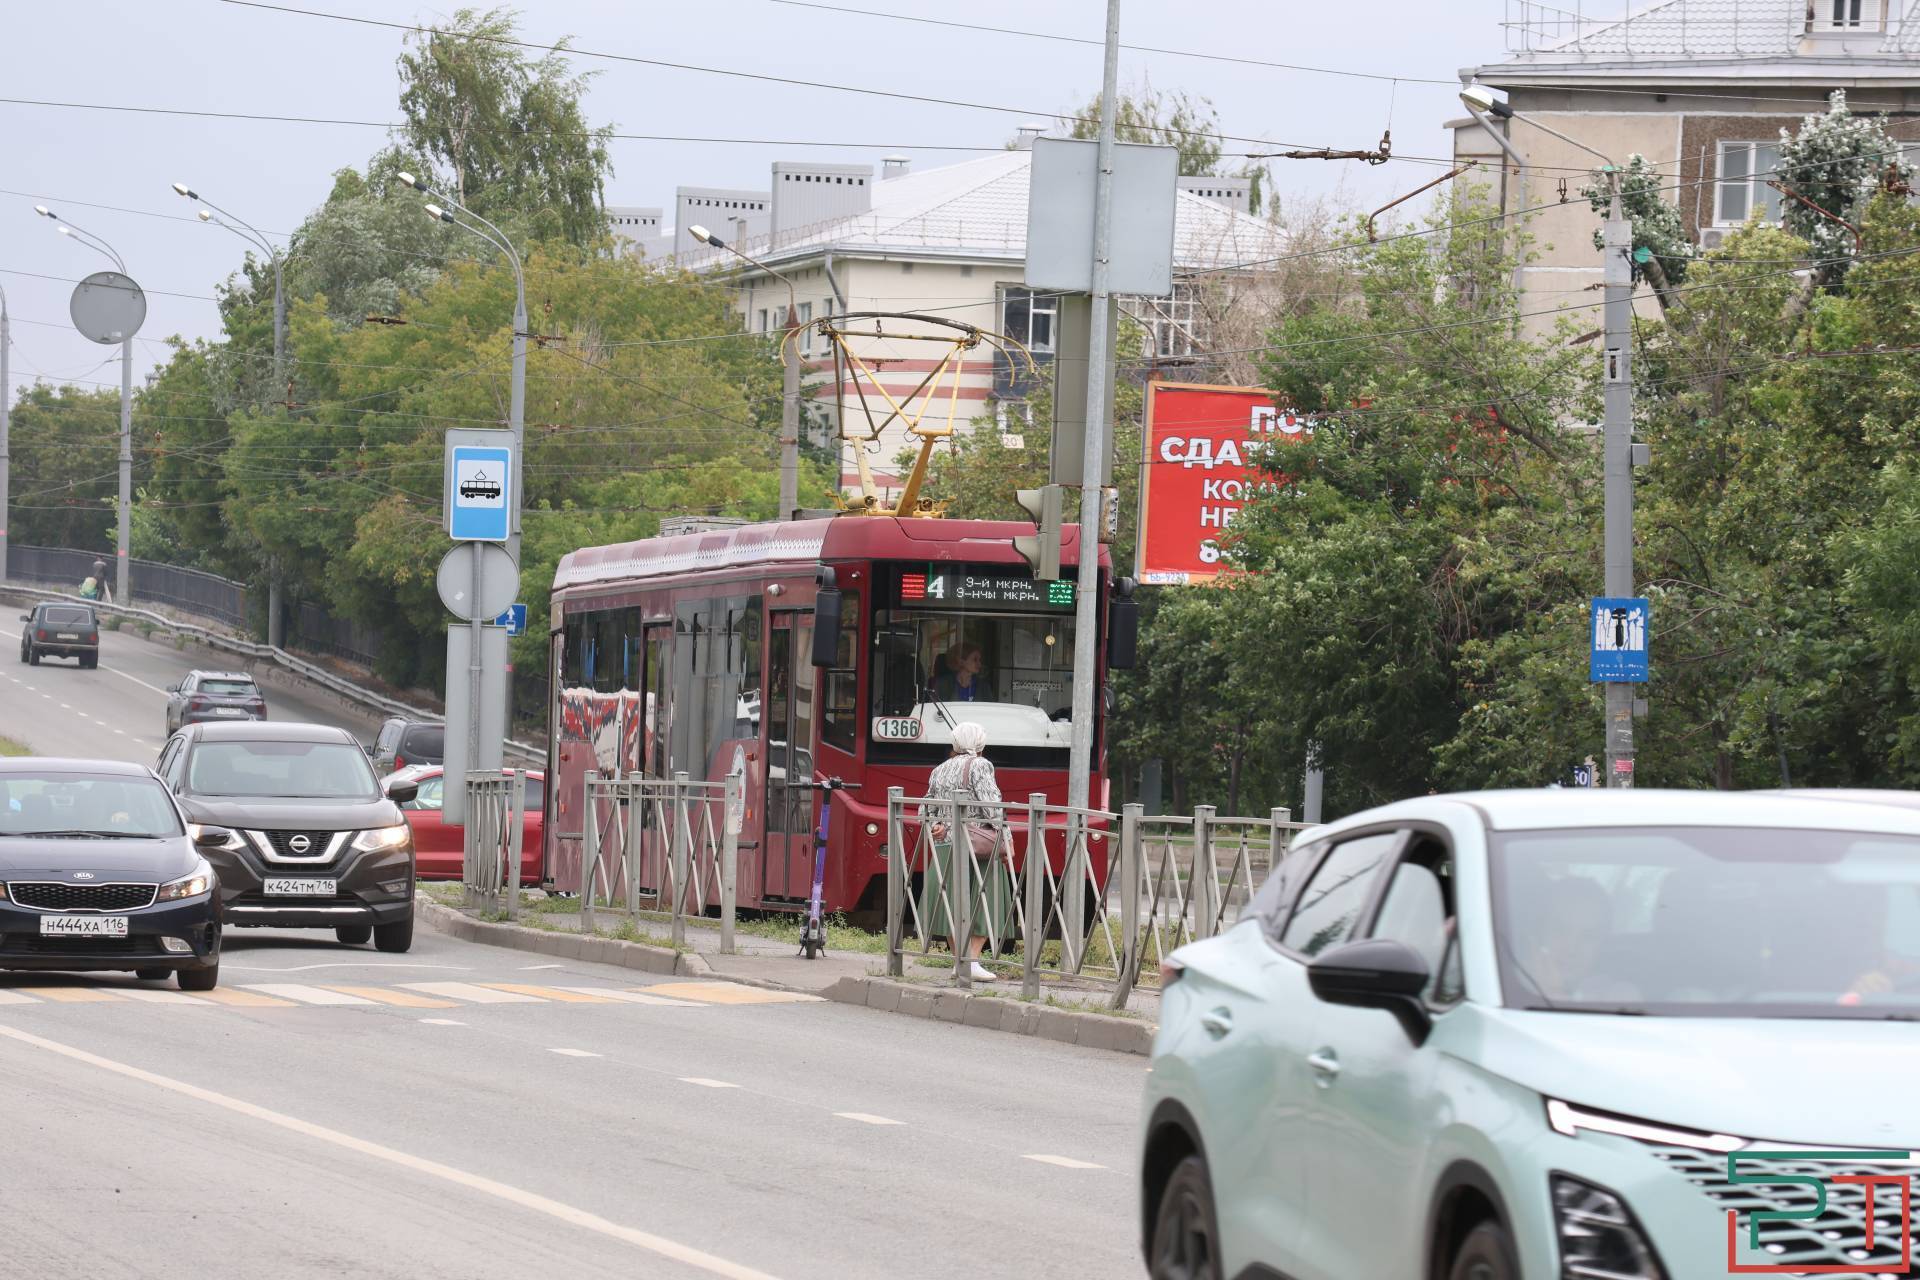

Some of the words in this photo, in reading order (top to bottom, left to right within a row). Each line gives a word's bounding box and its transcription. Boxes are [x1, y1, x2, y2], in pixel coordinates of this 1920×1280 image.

[927, 575, 945, 599] 4
[966, 576, 990, 588] 9-й
[996, 580, 1032, 590] мкрн.
[956, 587, 996, 599] 9-нчы
[1003, 591, 1040, 601] мкрн.
[881, 719, 919, 738] 1366
